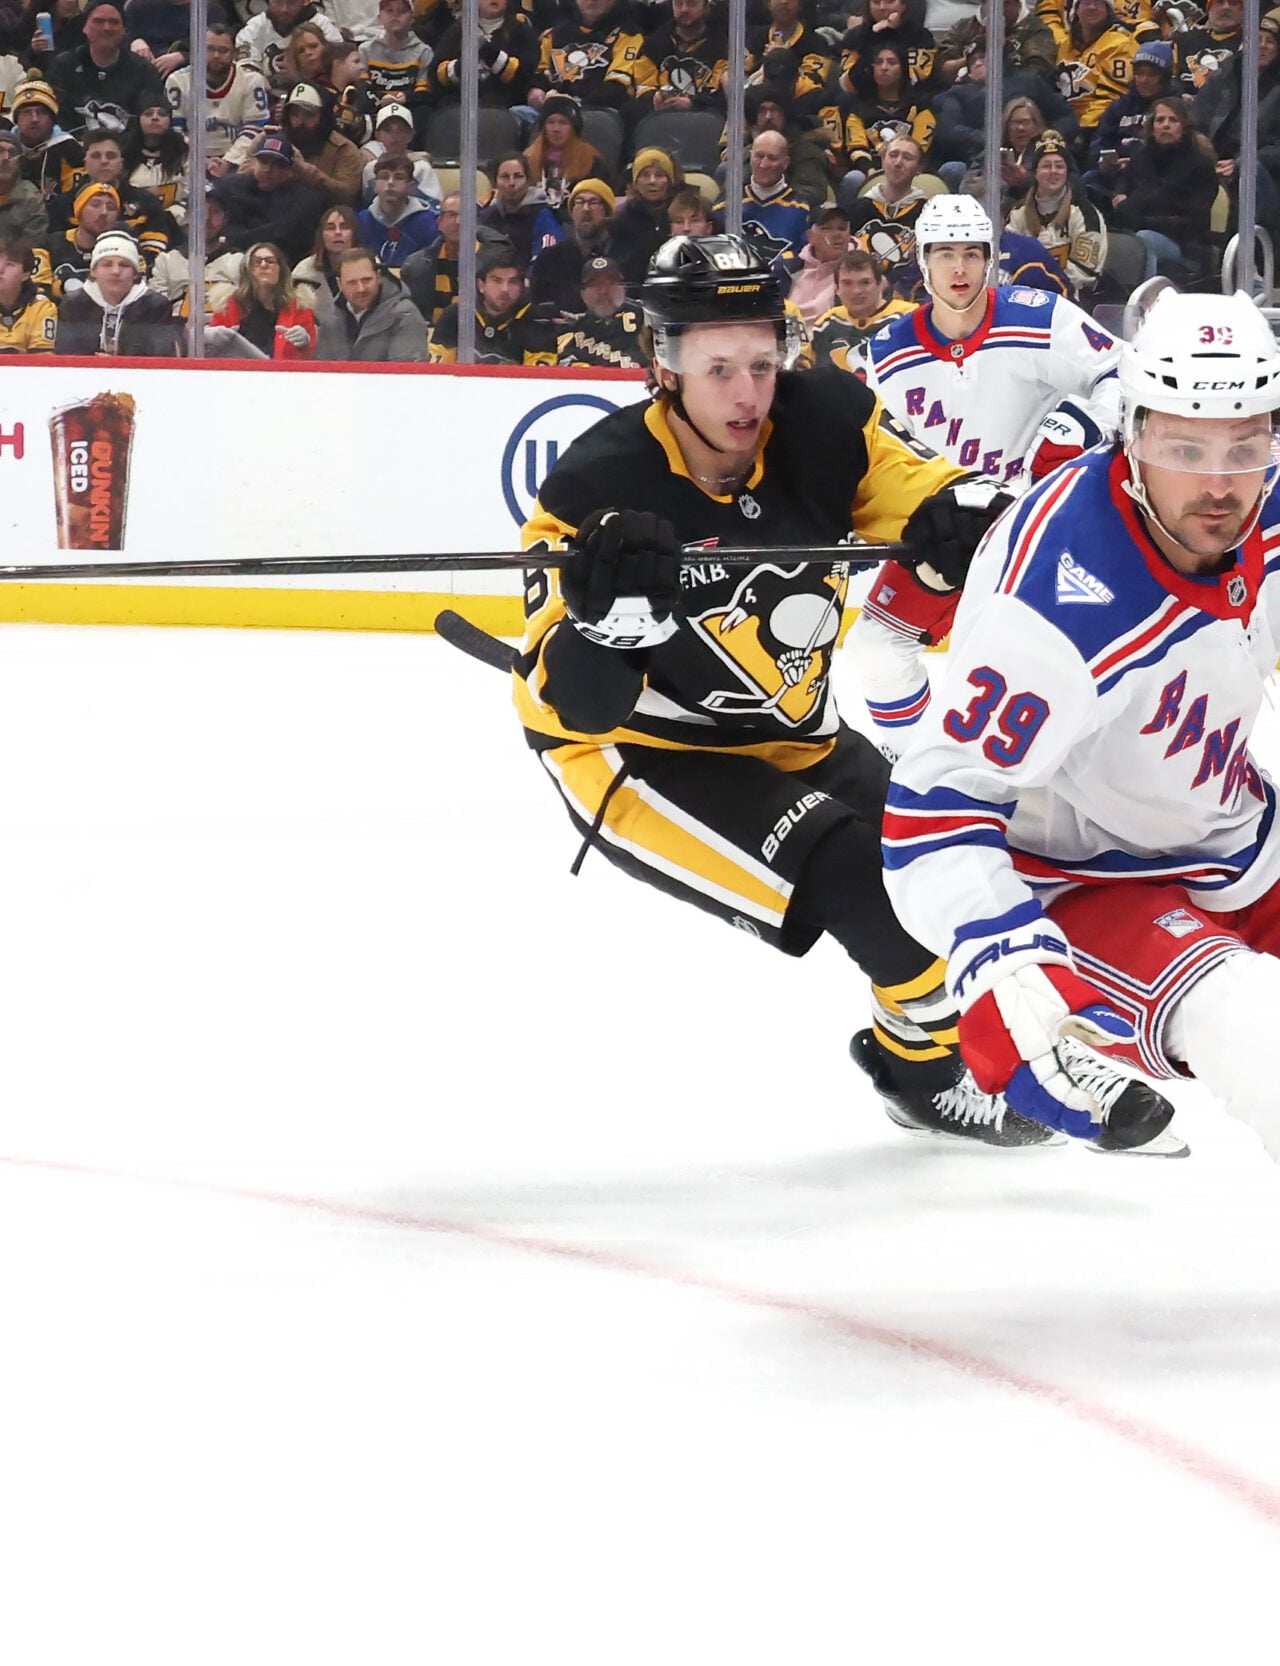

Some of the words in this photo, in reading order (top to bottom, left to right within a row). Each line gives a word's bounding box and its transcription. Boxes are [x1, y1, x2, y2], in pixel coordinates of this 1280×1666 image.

[714, 252, 743, 270] 81
[717, 285, 761, 294] BAUER
[1192, 381, 1245, 390] CCM
[71, 441, 88, 493] ICED
[943, 665, 1049, 768] 39
[760, 791, 833, 864] BAUER
[953, 934, 1067, 998] TRUE
